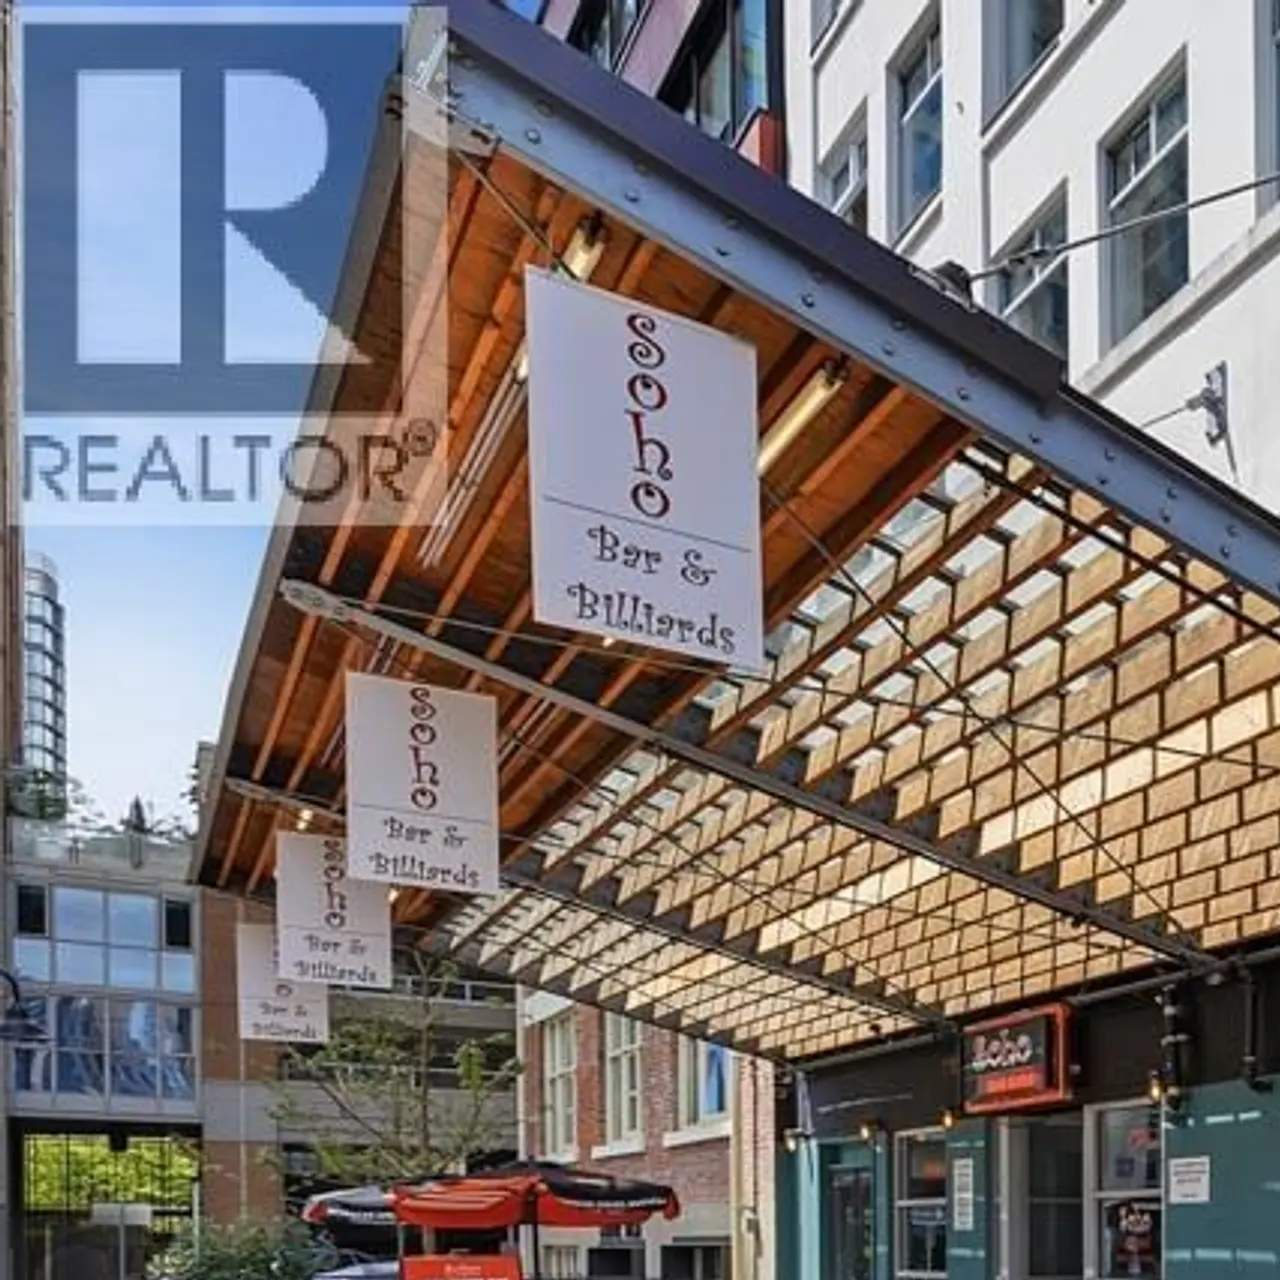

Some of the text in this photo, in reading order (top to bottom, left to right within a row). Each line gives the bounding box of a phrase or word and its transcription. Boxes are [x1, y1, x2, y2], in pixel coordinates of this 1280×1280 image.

[587, 525, 718, 587] Bar &
[566, 581, 736, 655] Billiards
[383, 815, 469, 847] Bar &
[369, 852, 481, 888] Billiards
[303, 934, 343, 953] Bar
[294, 960, 377, 983] Billiards
